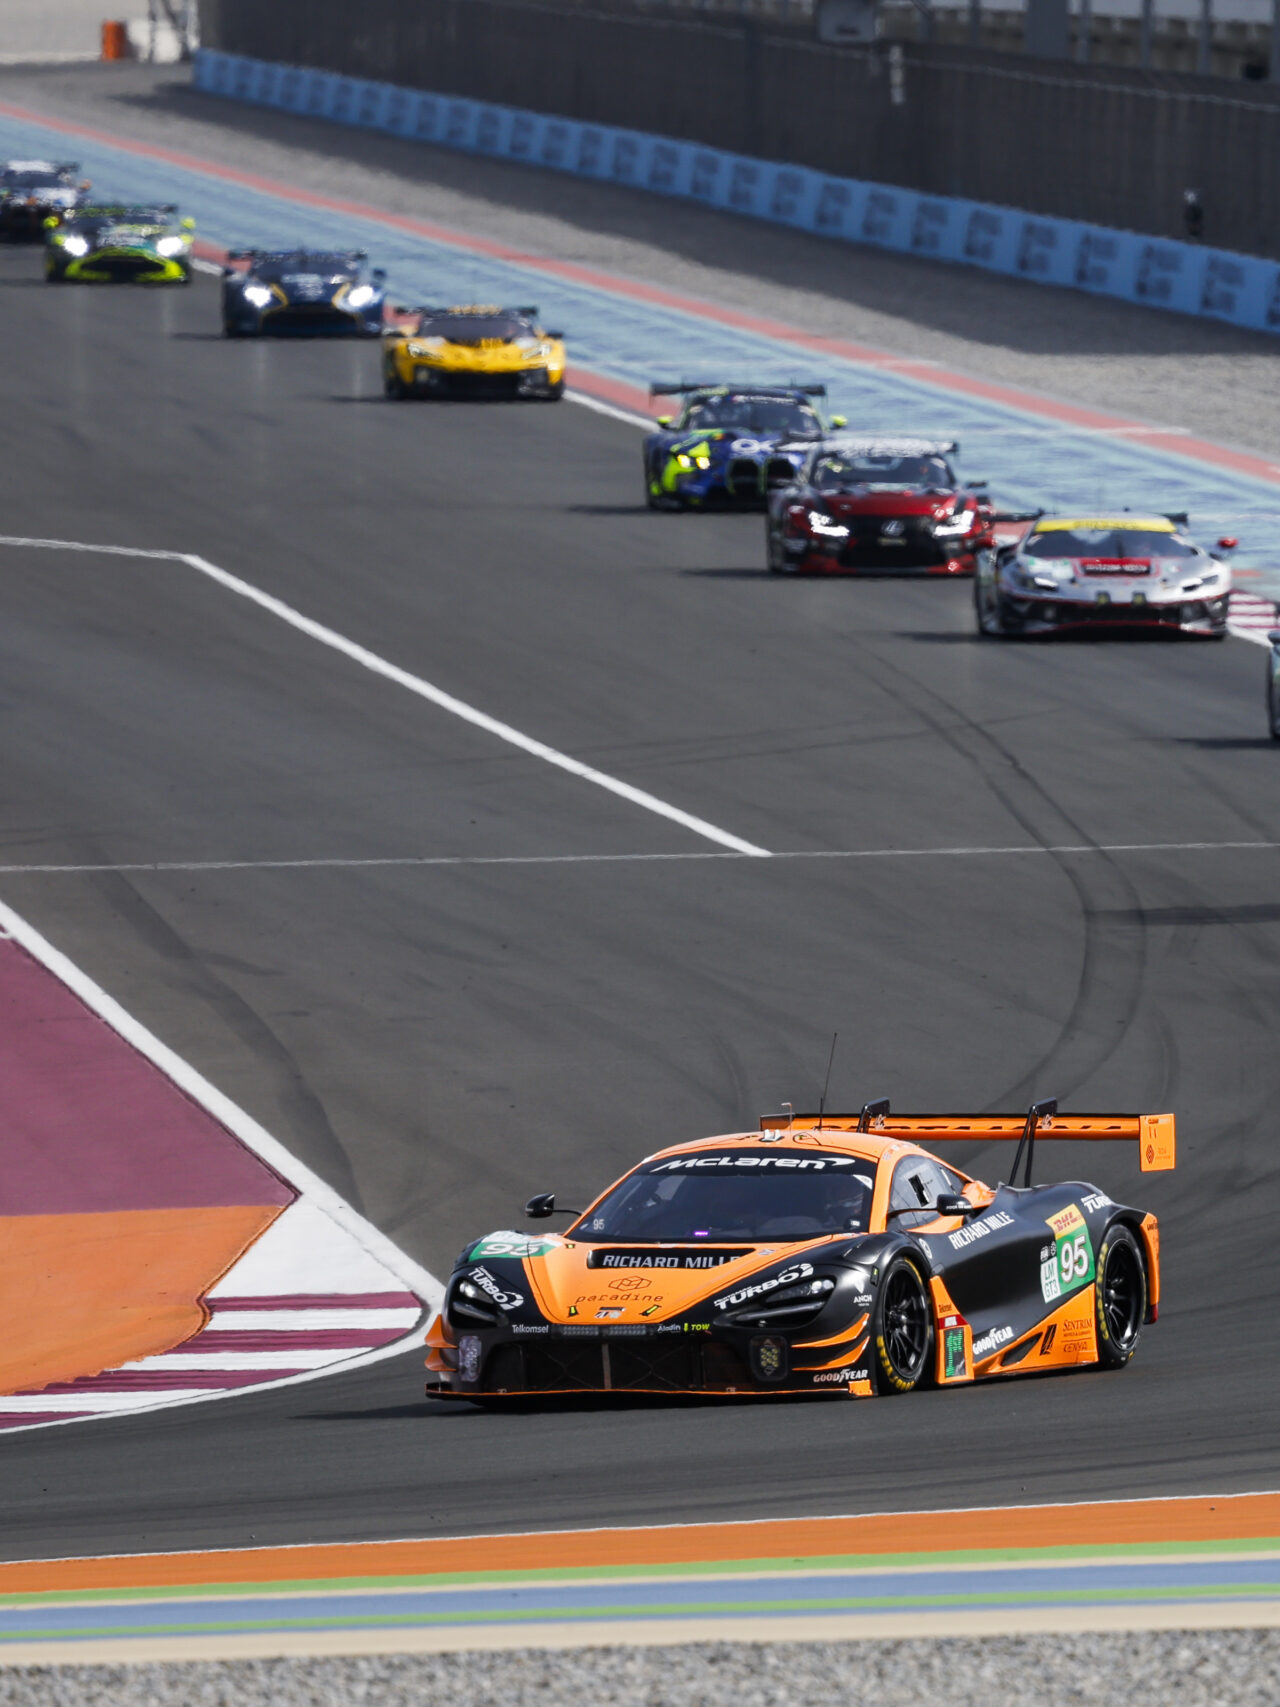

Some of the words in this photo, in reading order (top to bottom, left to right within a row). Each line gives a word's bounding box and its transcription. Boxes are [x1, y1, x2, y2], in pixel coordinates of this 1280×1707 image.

[650, 1157, 826, 1173] McLaren
[948, 1220, 990, 1250] RICHARD
[985, 1211, 1015, 1231] MILLE
[602, 1255, 679, 1268] RICHARD
[1060, 1234, 1089, 1284] 95
[1045, 1262, 1054, 1281] LM
[468, 1267, 509, 1304] TURBO
[714, 1270, 800, 1310] TURBO
[1045, 1279, 1058, 1299] GT3
[511, 1324, 549, 1334] Telkomsel
[691, 1323, 711, 1331] TOW
[972, 1326, 1015, 1355] GOODYEAR
[813, 1368, 868, 1383] GOODYEAR
